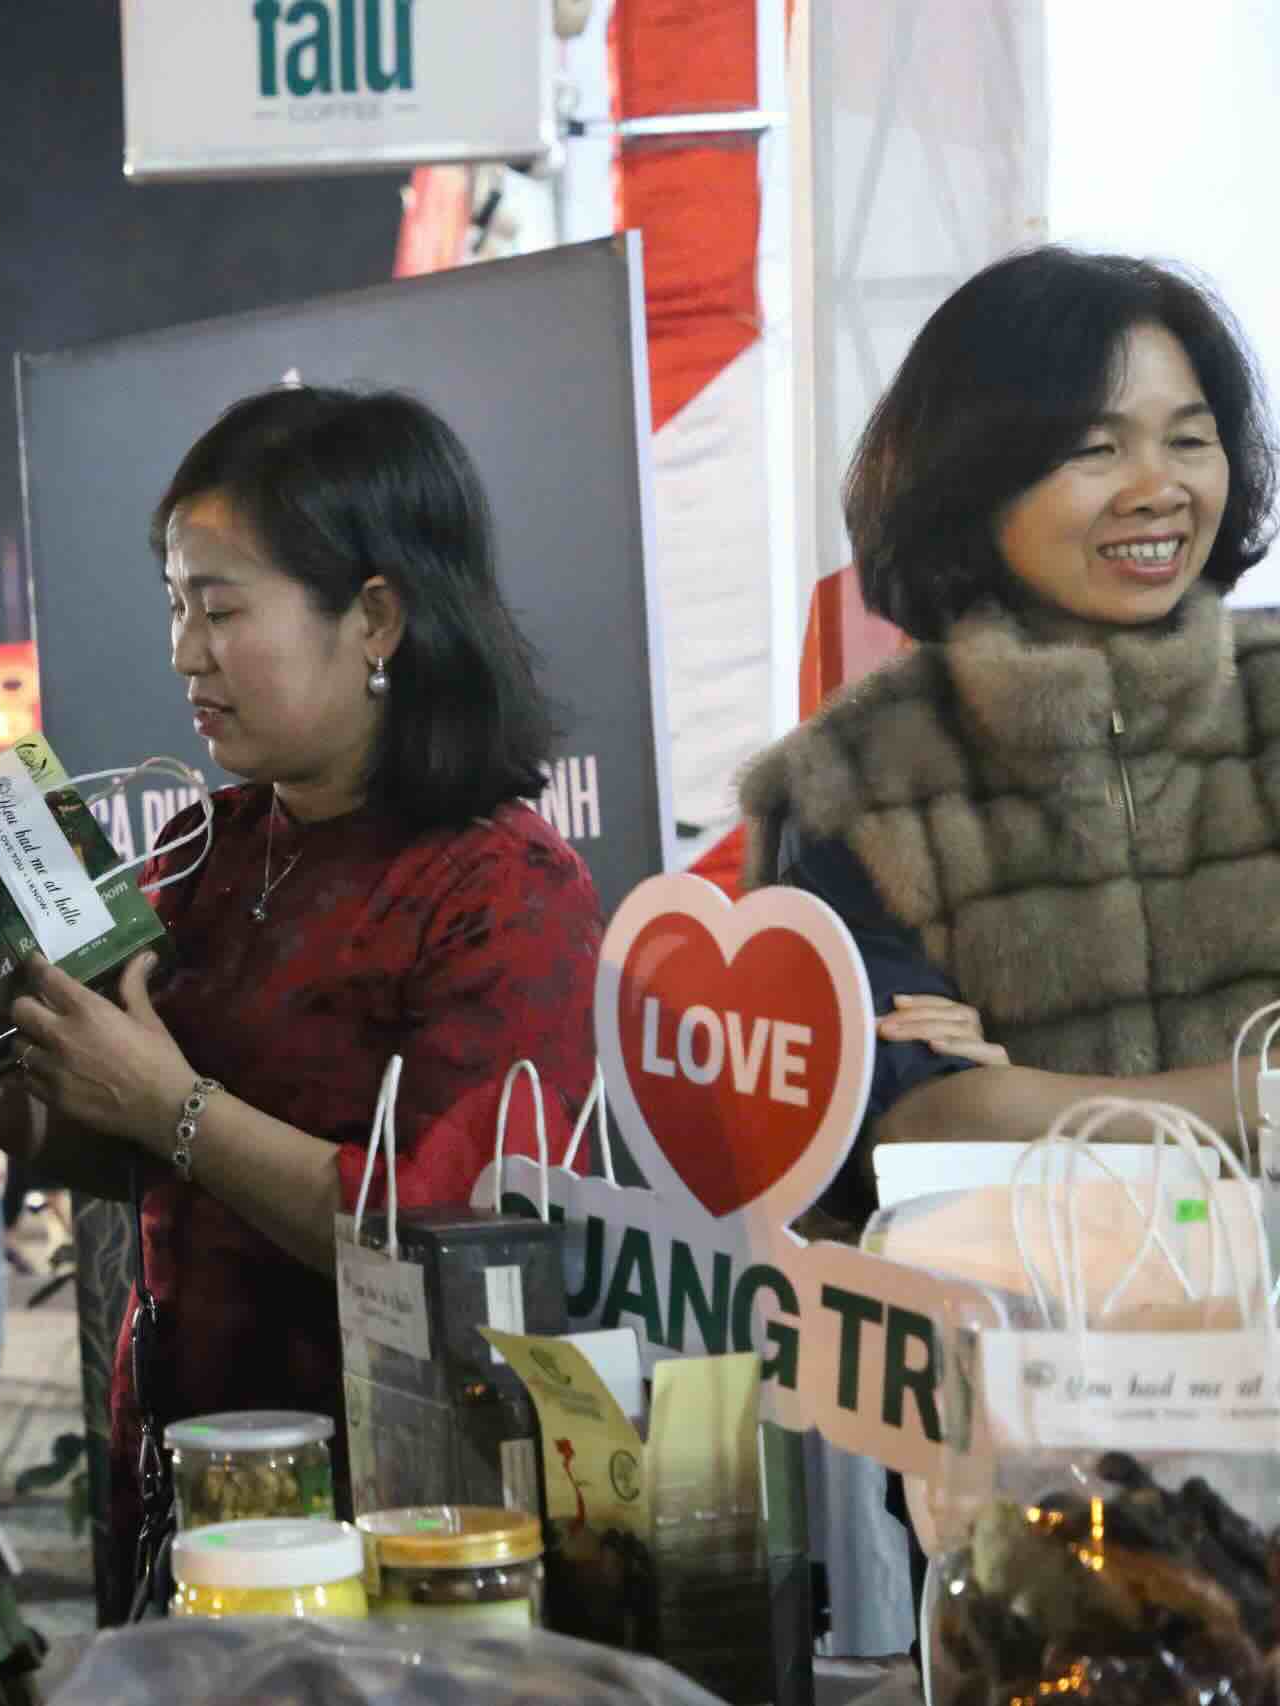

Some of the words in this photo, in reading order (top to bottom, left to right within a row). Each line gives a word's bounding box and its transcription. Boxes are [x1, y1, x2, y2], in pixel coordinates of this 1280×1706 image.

[15, 828, 41, 855] had
[31, 857, 48, 875] me
[45, 880, 63, 894] at
[54, 896, 82, 928] hello
[641, 996, 813, 1108] LOVE
[821, 1282, 960, 1446] TR
